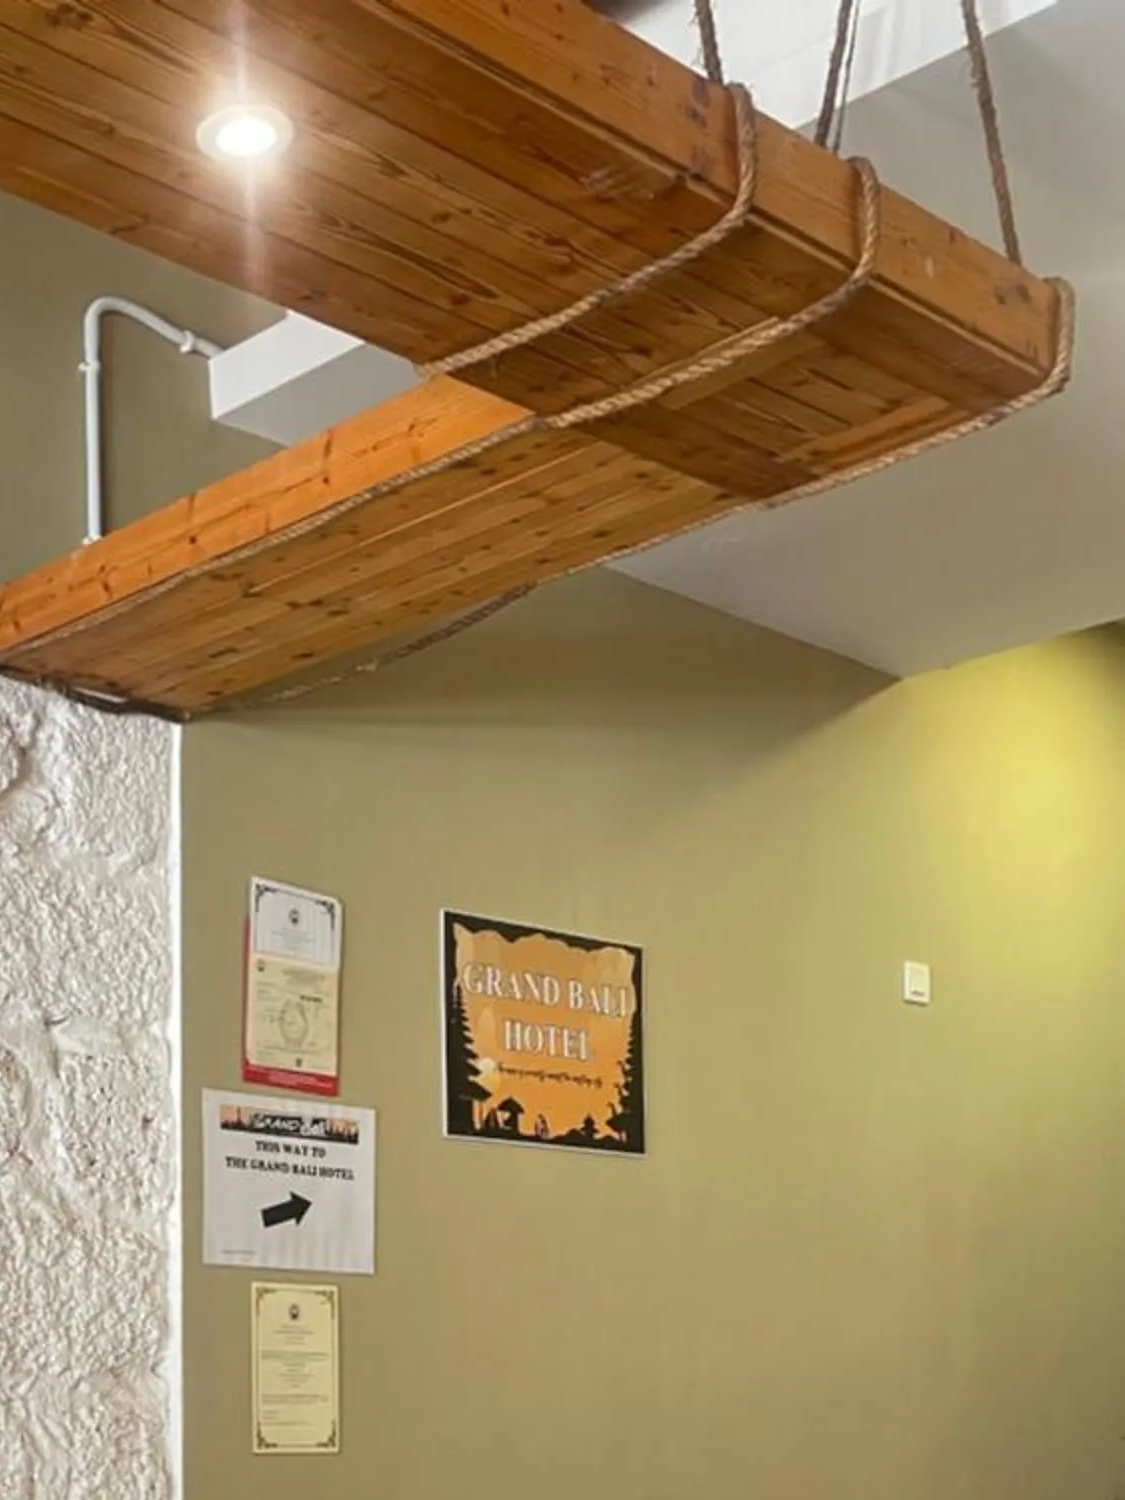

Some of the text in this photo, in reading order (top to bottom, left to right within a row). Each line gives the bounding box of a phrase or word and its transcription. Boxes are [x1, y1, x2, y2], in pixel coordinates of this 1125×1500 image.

[463, 963, 628, 1018] GRAND BALI
[505, 1019, 590, 1061] HOTEL
[255, 1140, 327, 1159] THIS WAY TO
[225, 1156, 355, 1181] THE GRAND BALI HOTEL
